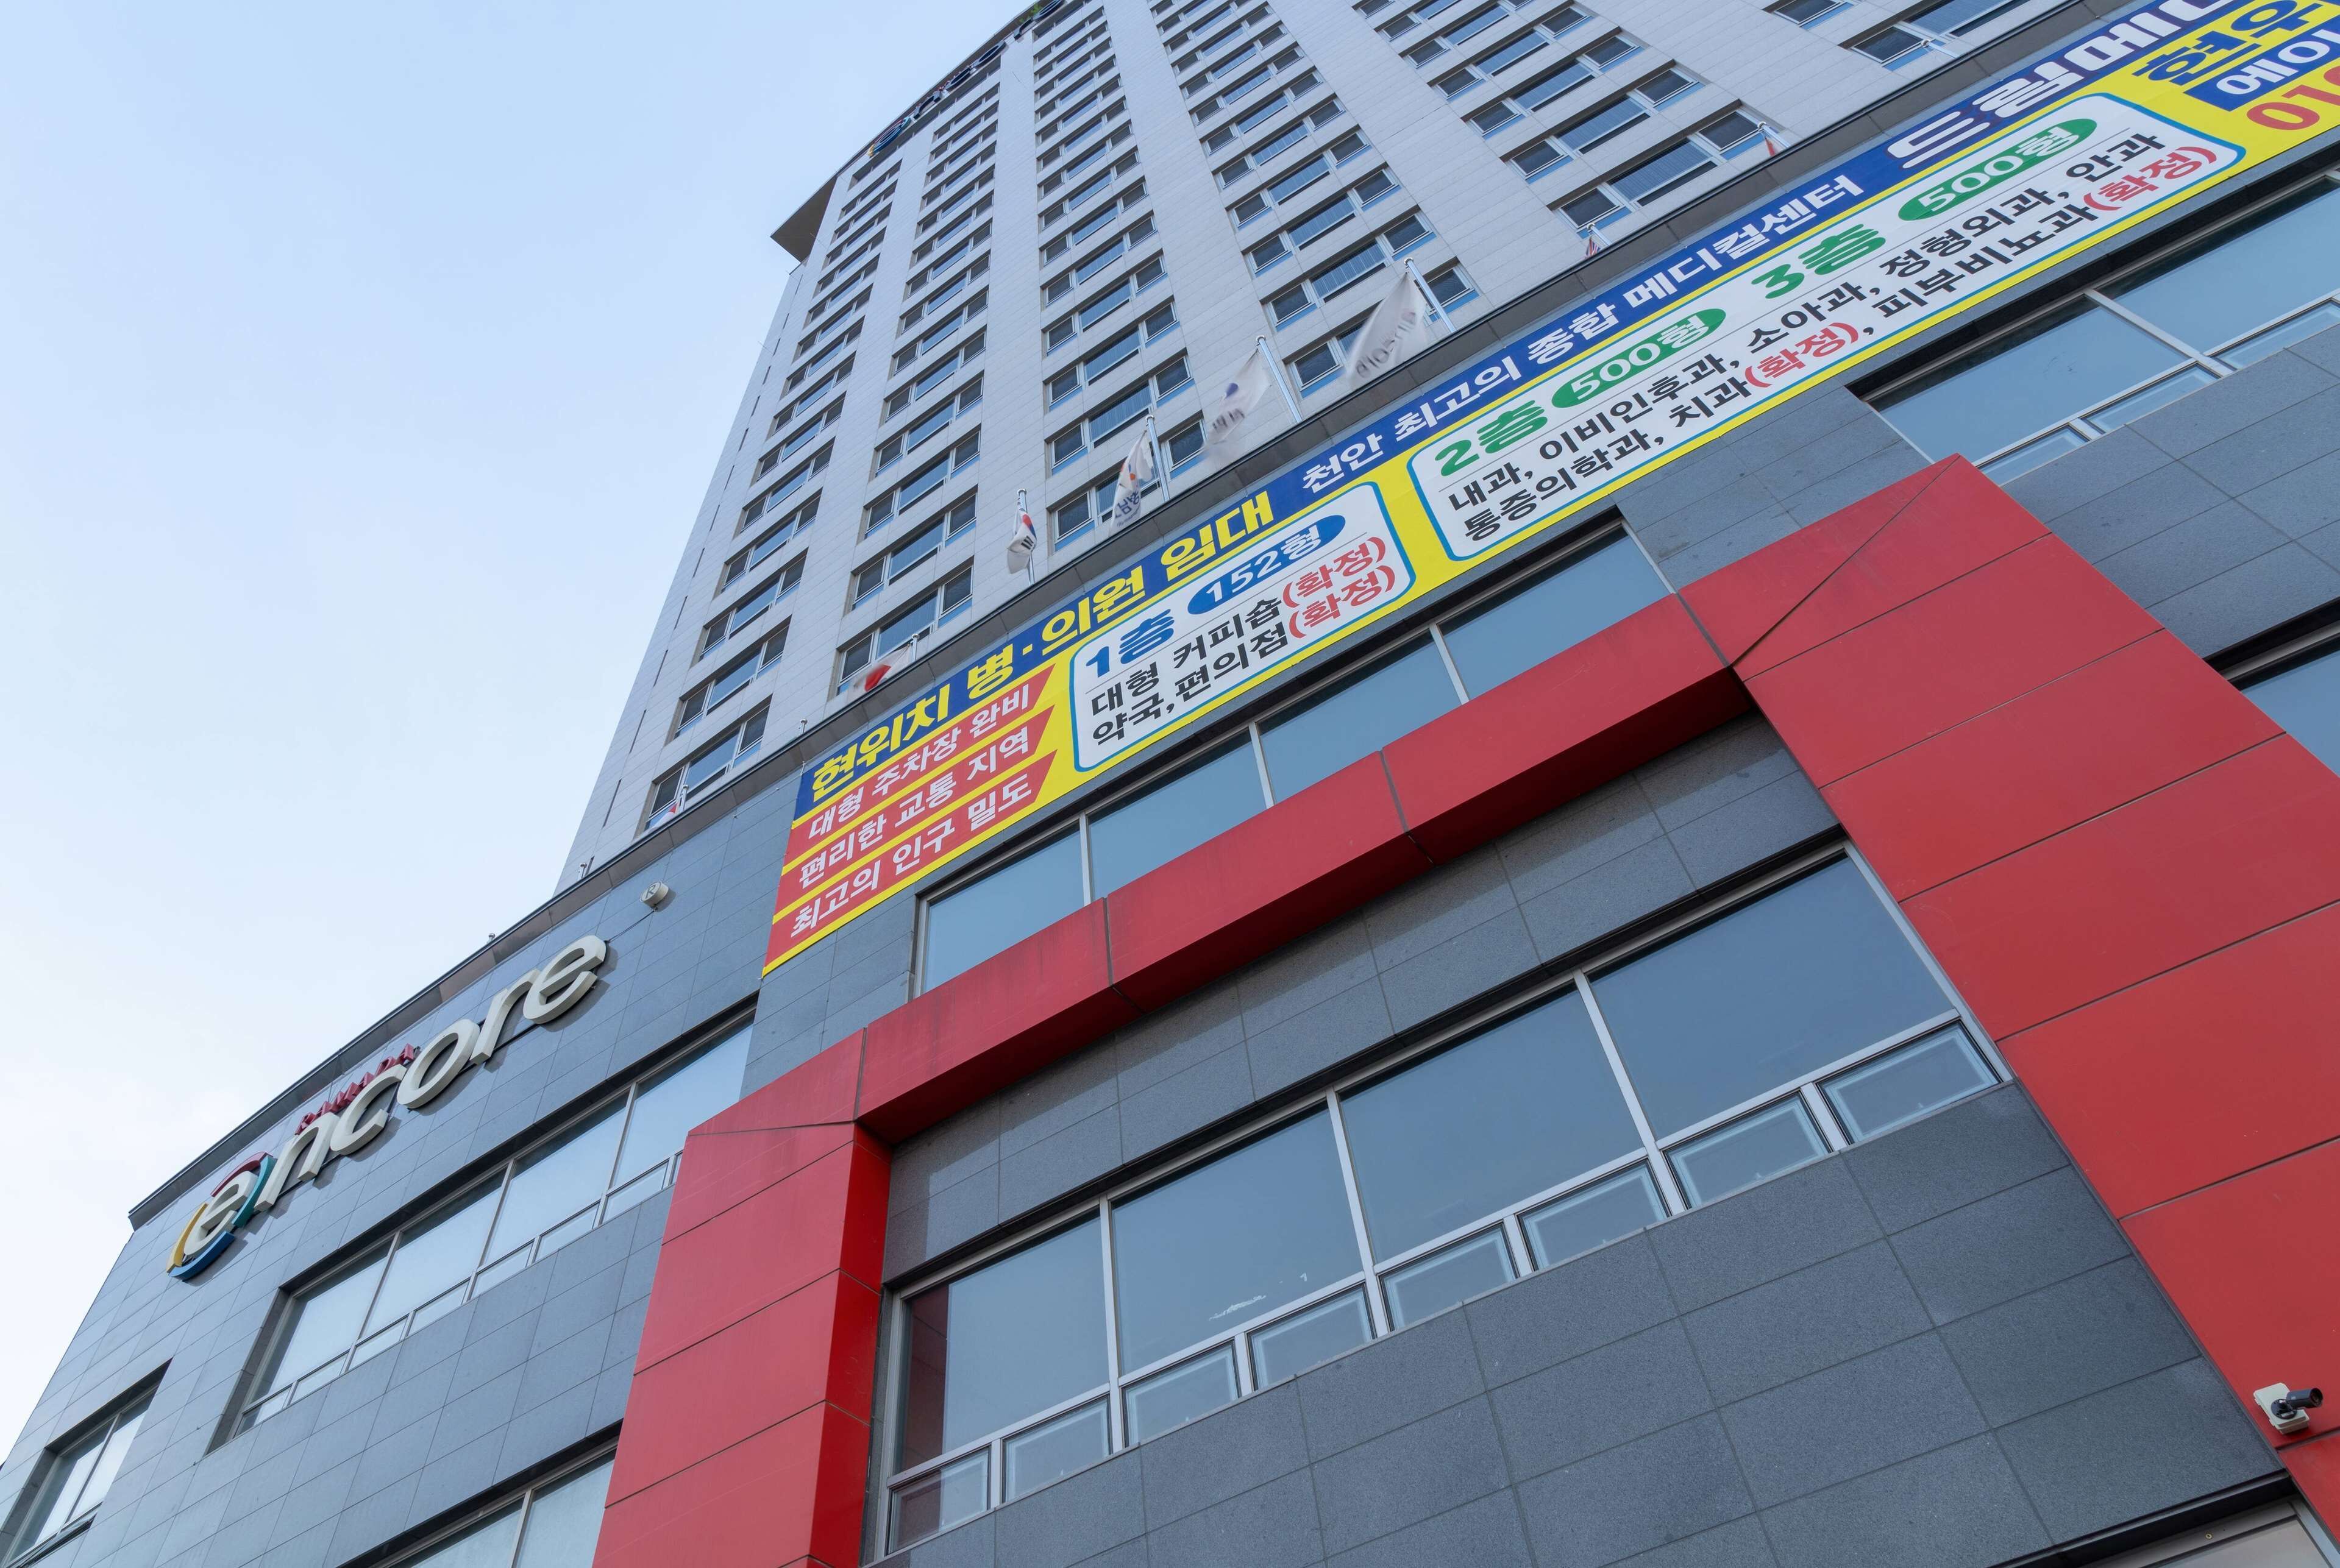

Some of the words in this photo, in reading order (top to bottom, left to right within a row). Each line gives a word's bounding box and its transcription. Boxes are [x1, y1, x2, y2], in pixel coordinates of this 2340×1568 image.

[1302, 433, 1384, 493] 천안
[1395, 355, 1523, 442] 최고의
[1527, 302, 1620, 364] 종합
[1623, 174, 1864, 308] 메디컬센터
[1448, 462, 1533, 511] 내과,
[1539, 353, 1740, 459] 이비인후과,
[1746, 281, 1880, 353] 소아과,
[1879, 187, 2069, 278] 정형외과,
[2066, 133, 2167, 183] 안과
[1751, 224, 1885, 299] 3층
[1434, 400, 1548, 477] 2층
[1464, 428, 1663, 541] 통증의학과,
[812, 684, 950, 803] 현위치
[1161, 491, 1274, 581] 임대
[1086, 609, 1175, 678] 1층
[1092, 661, 1159, 716] 대형
[799, 818, 887, 889] 편리한
[895, 772, 956, 828] 교통
[967, 726, 1029, 781] 지역
[808, 786, 864, 839] 대형
[872, 729, 961, 796] 주차장
[970, 684, 1030, 739] 완비
[791, 860, 881, 938] 최고의
[892, 818, 955, 876] 인구
[967, 773, 1032, 831] 밀도
[183, 934, 607, 1258] encore
